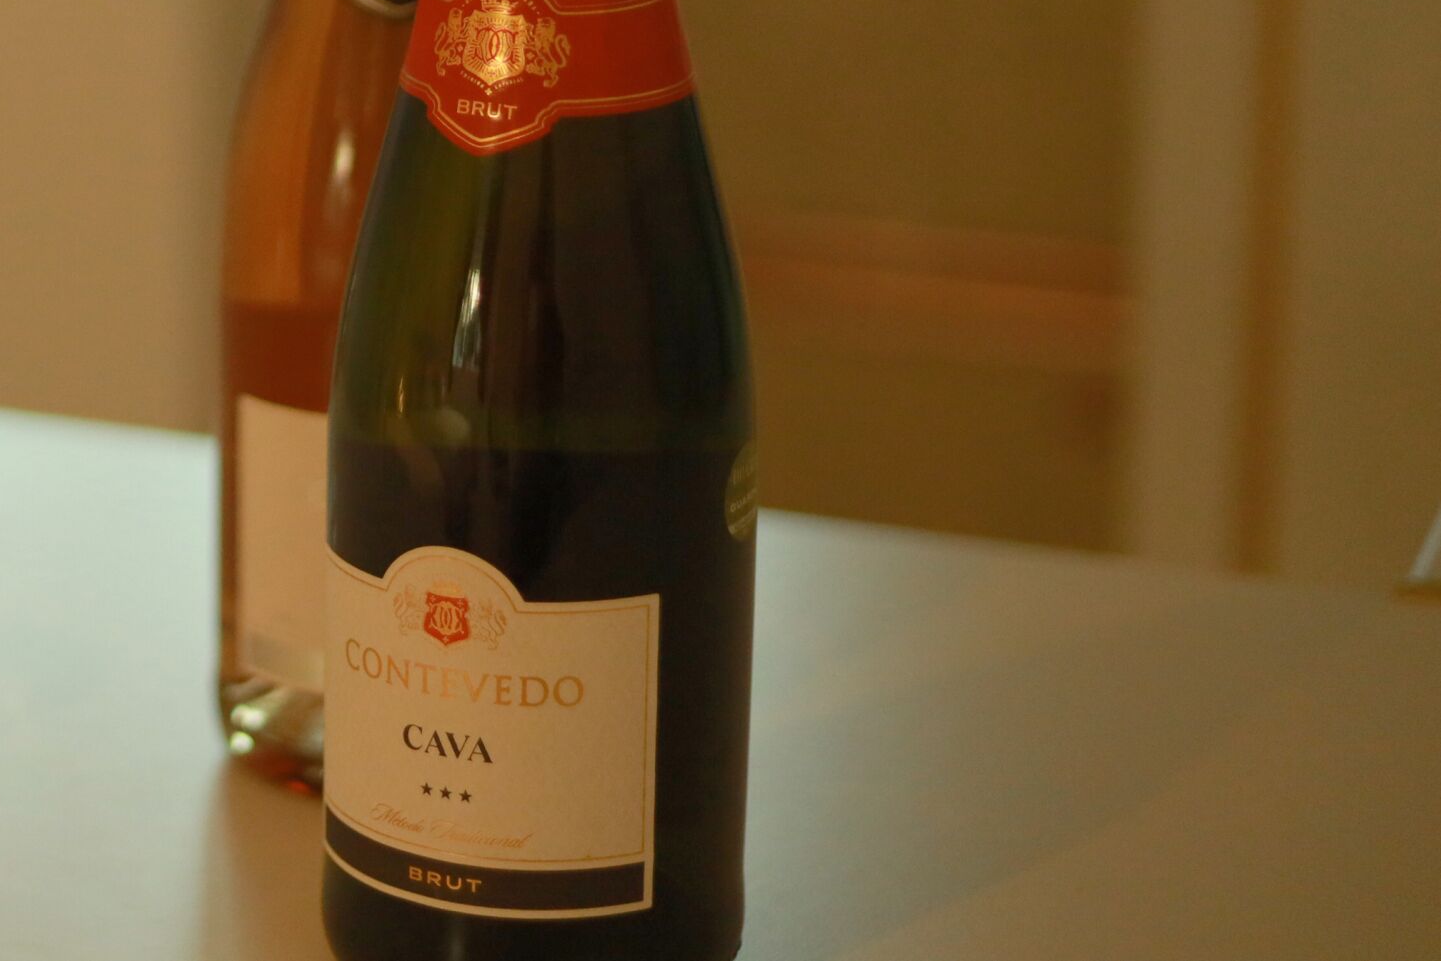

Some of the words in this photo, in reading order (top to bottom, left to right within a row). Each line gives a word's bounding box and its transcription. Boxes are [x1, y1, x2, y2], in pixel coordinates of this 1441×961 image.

[456, 98, 518, 121] BRUT
[345, 637, 586, 708] CONTEVEDO
[402, 723, 494, 764] CAVA
[408, 865, 483, 893] BRUT
